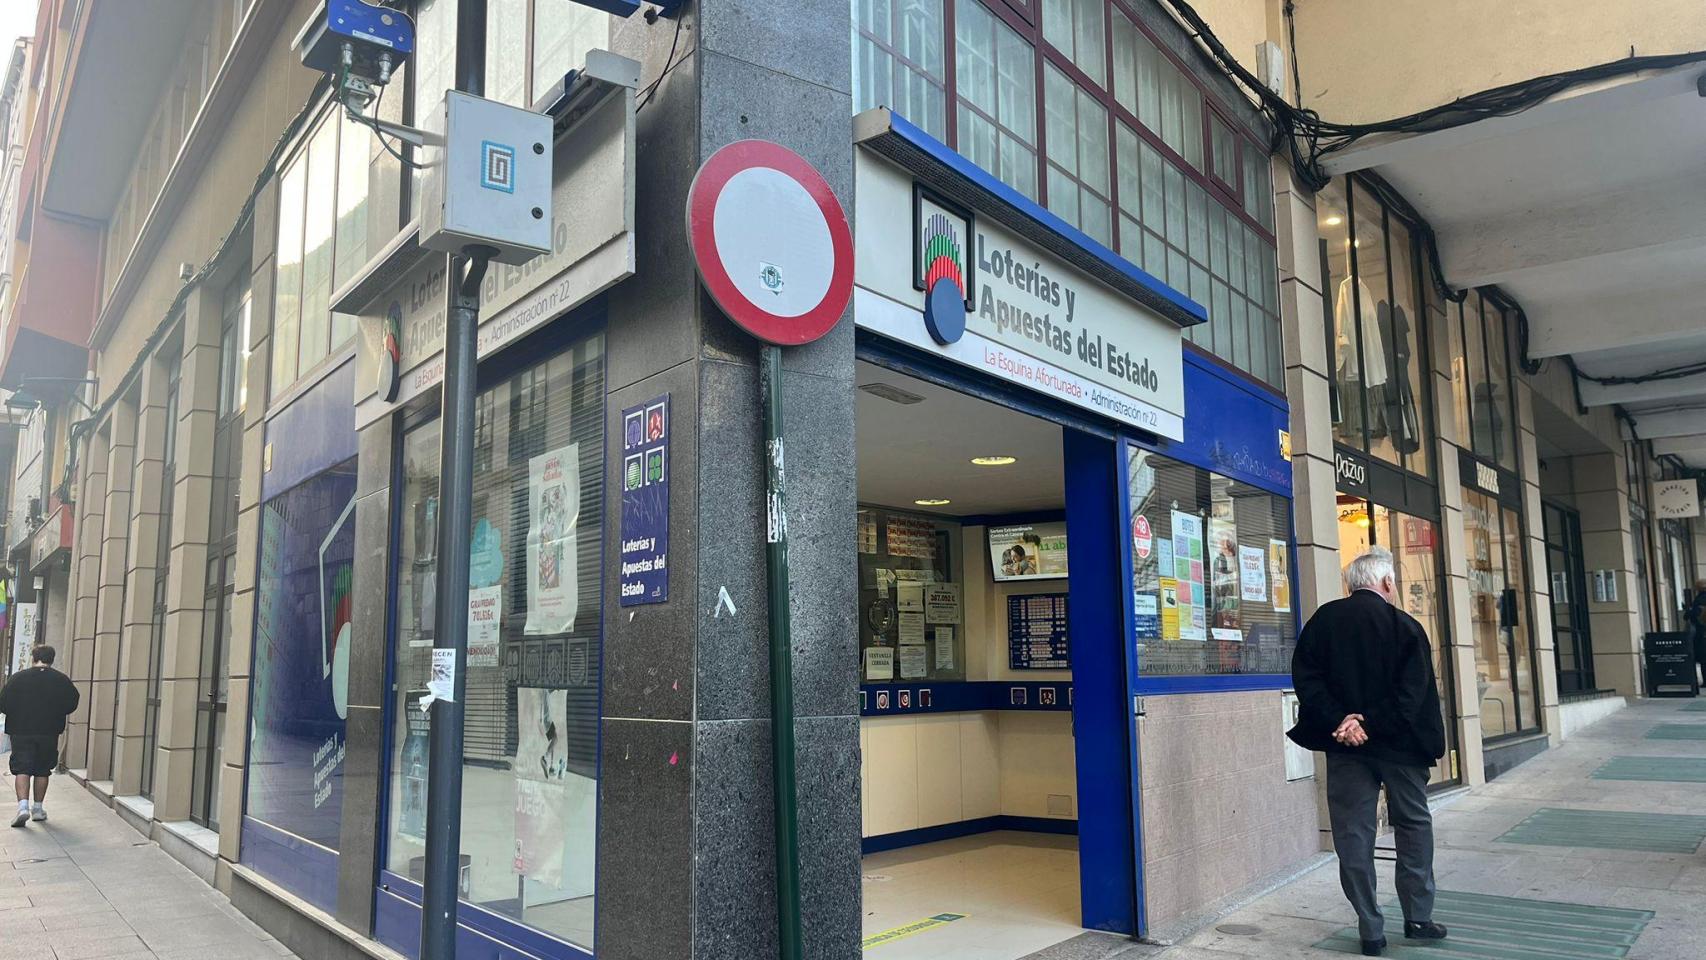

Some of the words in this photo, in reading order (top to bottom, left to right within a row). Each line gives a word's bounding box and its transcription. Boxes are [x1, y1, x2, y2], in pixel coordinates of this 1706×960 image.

[411, 268, 447, 314] Loter
[978, 233, 1060, 307] Loterías
[1065, 288, 1075, 323] y
[410, 309, 446, 356] Apue
[491, 295, 548, 343] Administración
[559, 279, 570, 303] 22
[980, 284, 1072, 356] Apuestas
[1077, 327, 1102, 370] del
[1106, 342, 1158, 393] Estado
[415, 373, 422, 390] La
[985, 346, 996, 366] La
[998, 352, 1032, 380] Esquina
[1035, 367, 1082, 398] Afortunada
[1091, 388, 1142, 422] Administración
[1150, 410, 1158, 427] 22
[622, 536, 650, 554] Loterías
[650, 537, 656, 552] y
[622, 558, 653, 577] Apuestas
[654, 554, 665, 570] del
[621, 580, 645, 597] Estado
[313, 736, 333, 768] Loterías
[313, 755, 337, 790] Apuestas
[337, 740, 346, 764] del
[314, 781, 332, 809] Estado
